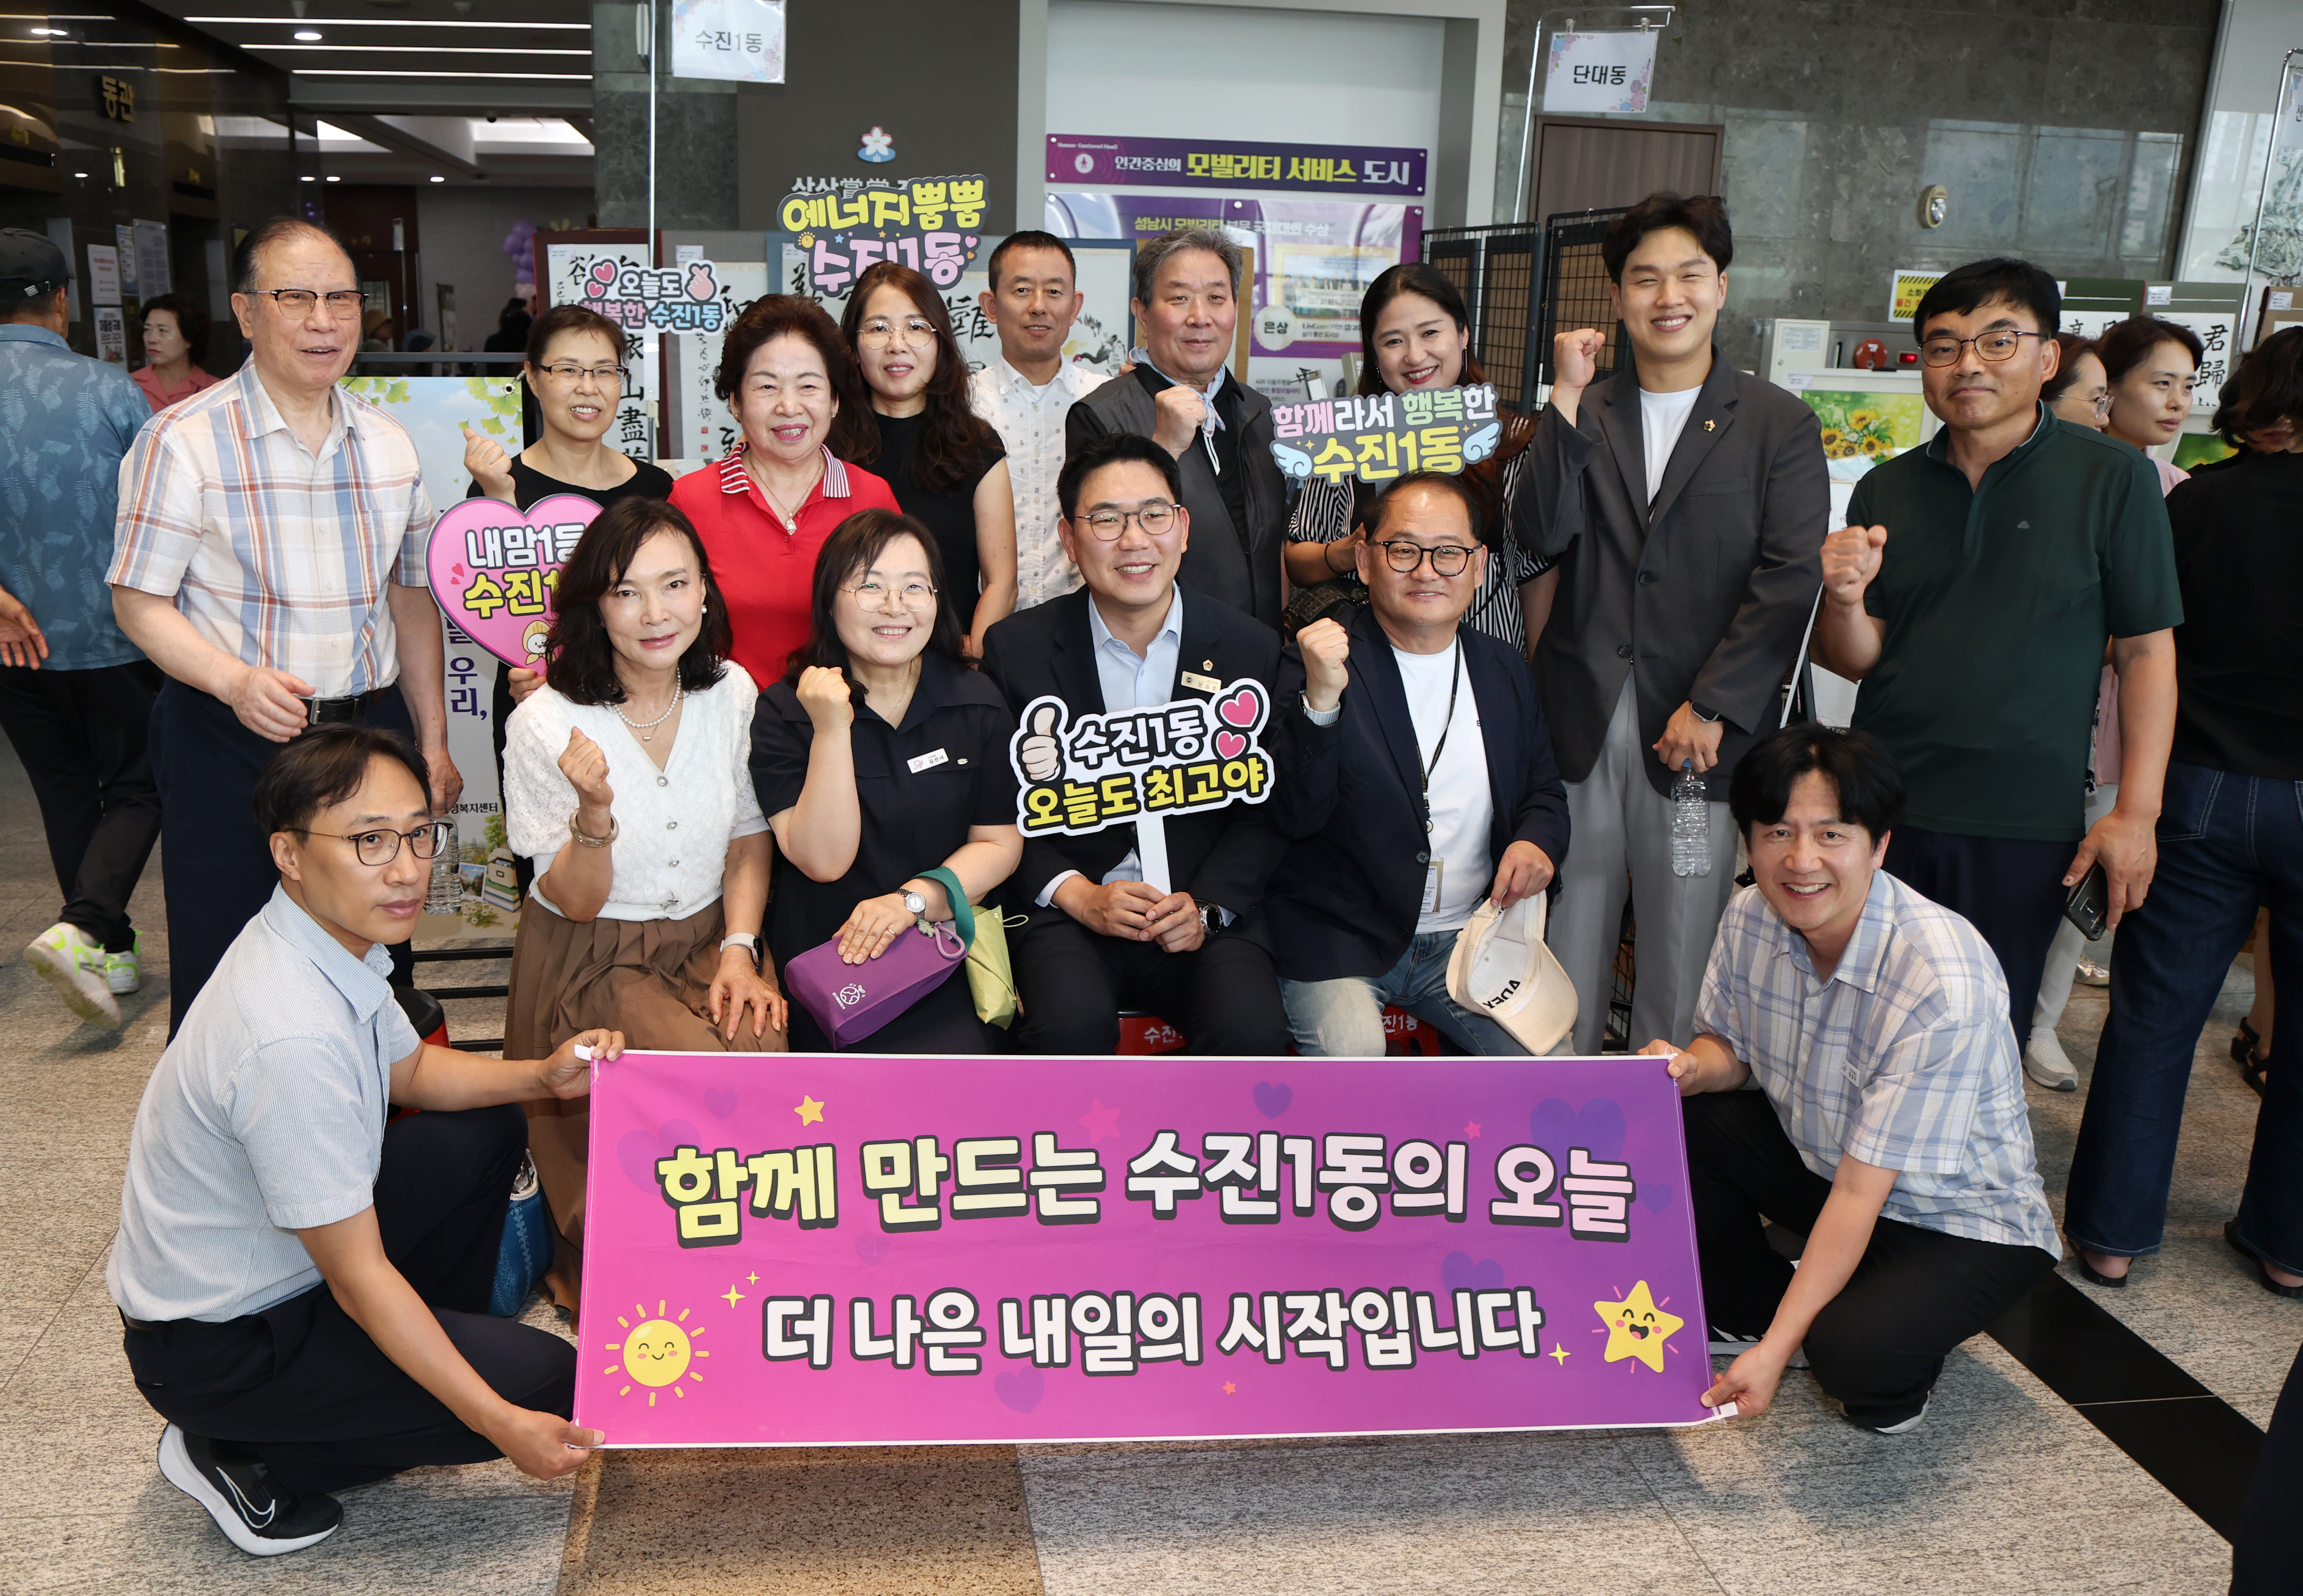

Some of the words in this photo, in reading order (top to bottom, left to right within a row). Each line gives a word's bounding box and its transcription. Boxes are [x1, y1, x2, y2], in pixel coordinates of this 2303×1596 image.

[696, 30, 762, 53] 수진1동
[1573, 65, 1626, 85] 단대동
[102, 75, 135, 122] 동관
[1114, 155, 1181, 172] 인간중심의
[1185, 153, 1281, 180] 모빌리티
[1285, 157, 1357, 183] 서비스
[1362, 160, 1410, 185] 도시
[1134, 216, 1172, 232] 성남시
[620, 271, 681, 296] 오늘도
[650, 303, 721, 330] 수진1동
[1264, 321, 1288, 334] 은상
[1272, 394, 1395, 439] 함께라서
[1401, 385, 1495, 426] 행복한
[1313, 425, 1463, 484] 수진1동
[463, 569, 560, 618] 수진1
[1074, 707, 1202, 765] 수진1동
[1027, 775, 1138, 827] 오늘도
[1146, 756, 1266, 810] 최고야
[1143, 1025, 1183, 1044] 수진
[1382, 1014, 1418, 1033] 진1동
[657, 1142, 837, 1244] 함께
[861, 1131, 1105, 1229] 만드는
[1126, 1131, 1468, 1227] 수진1동의
[1490, 1146, 1635, 1240] 오늘
[764, 1295, 833, 1369] 더
[851, 1288, 984, 1374] 나은
[1000, 1291, 1201, 1375] 내일의
[1218, 1286, 1544, 1369] 시작입니다
